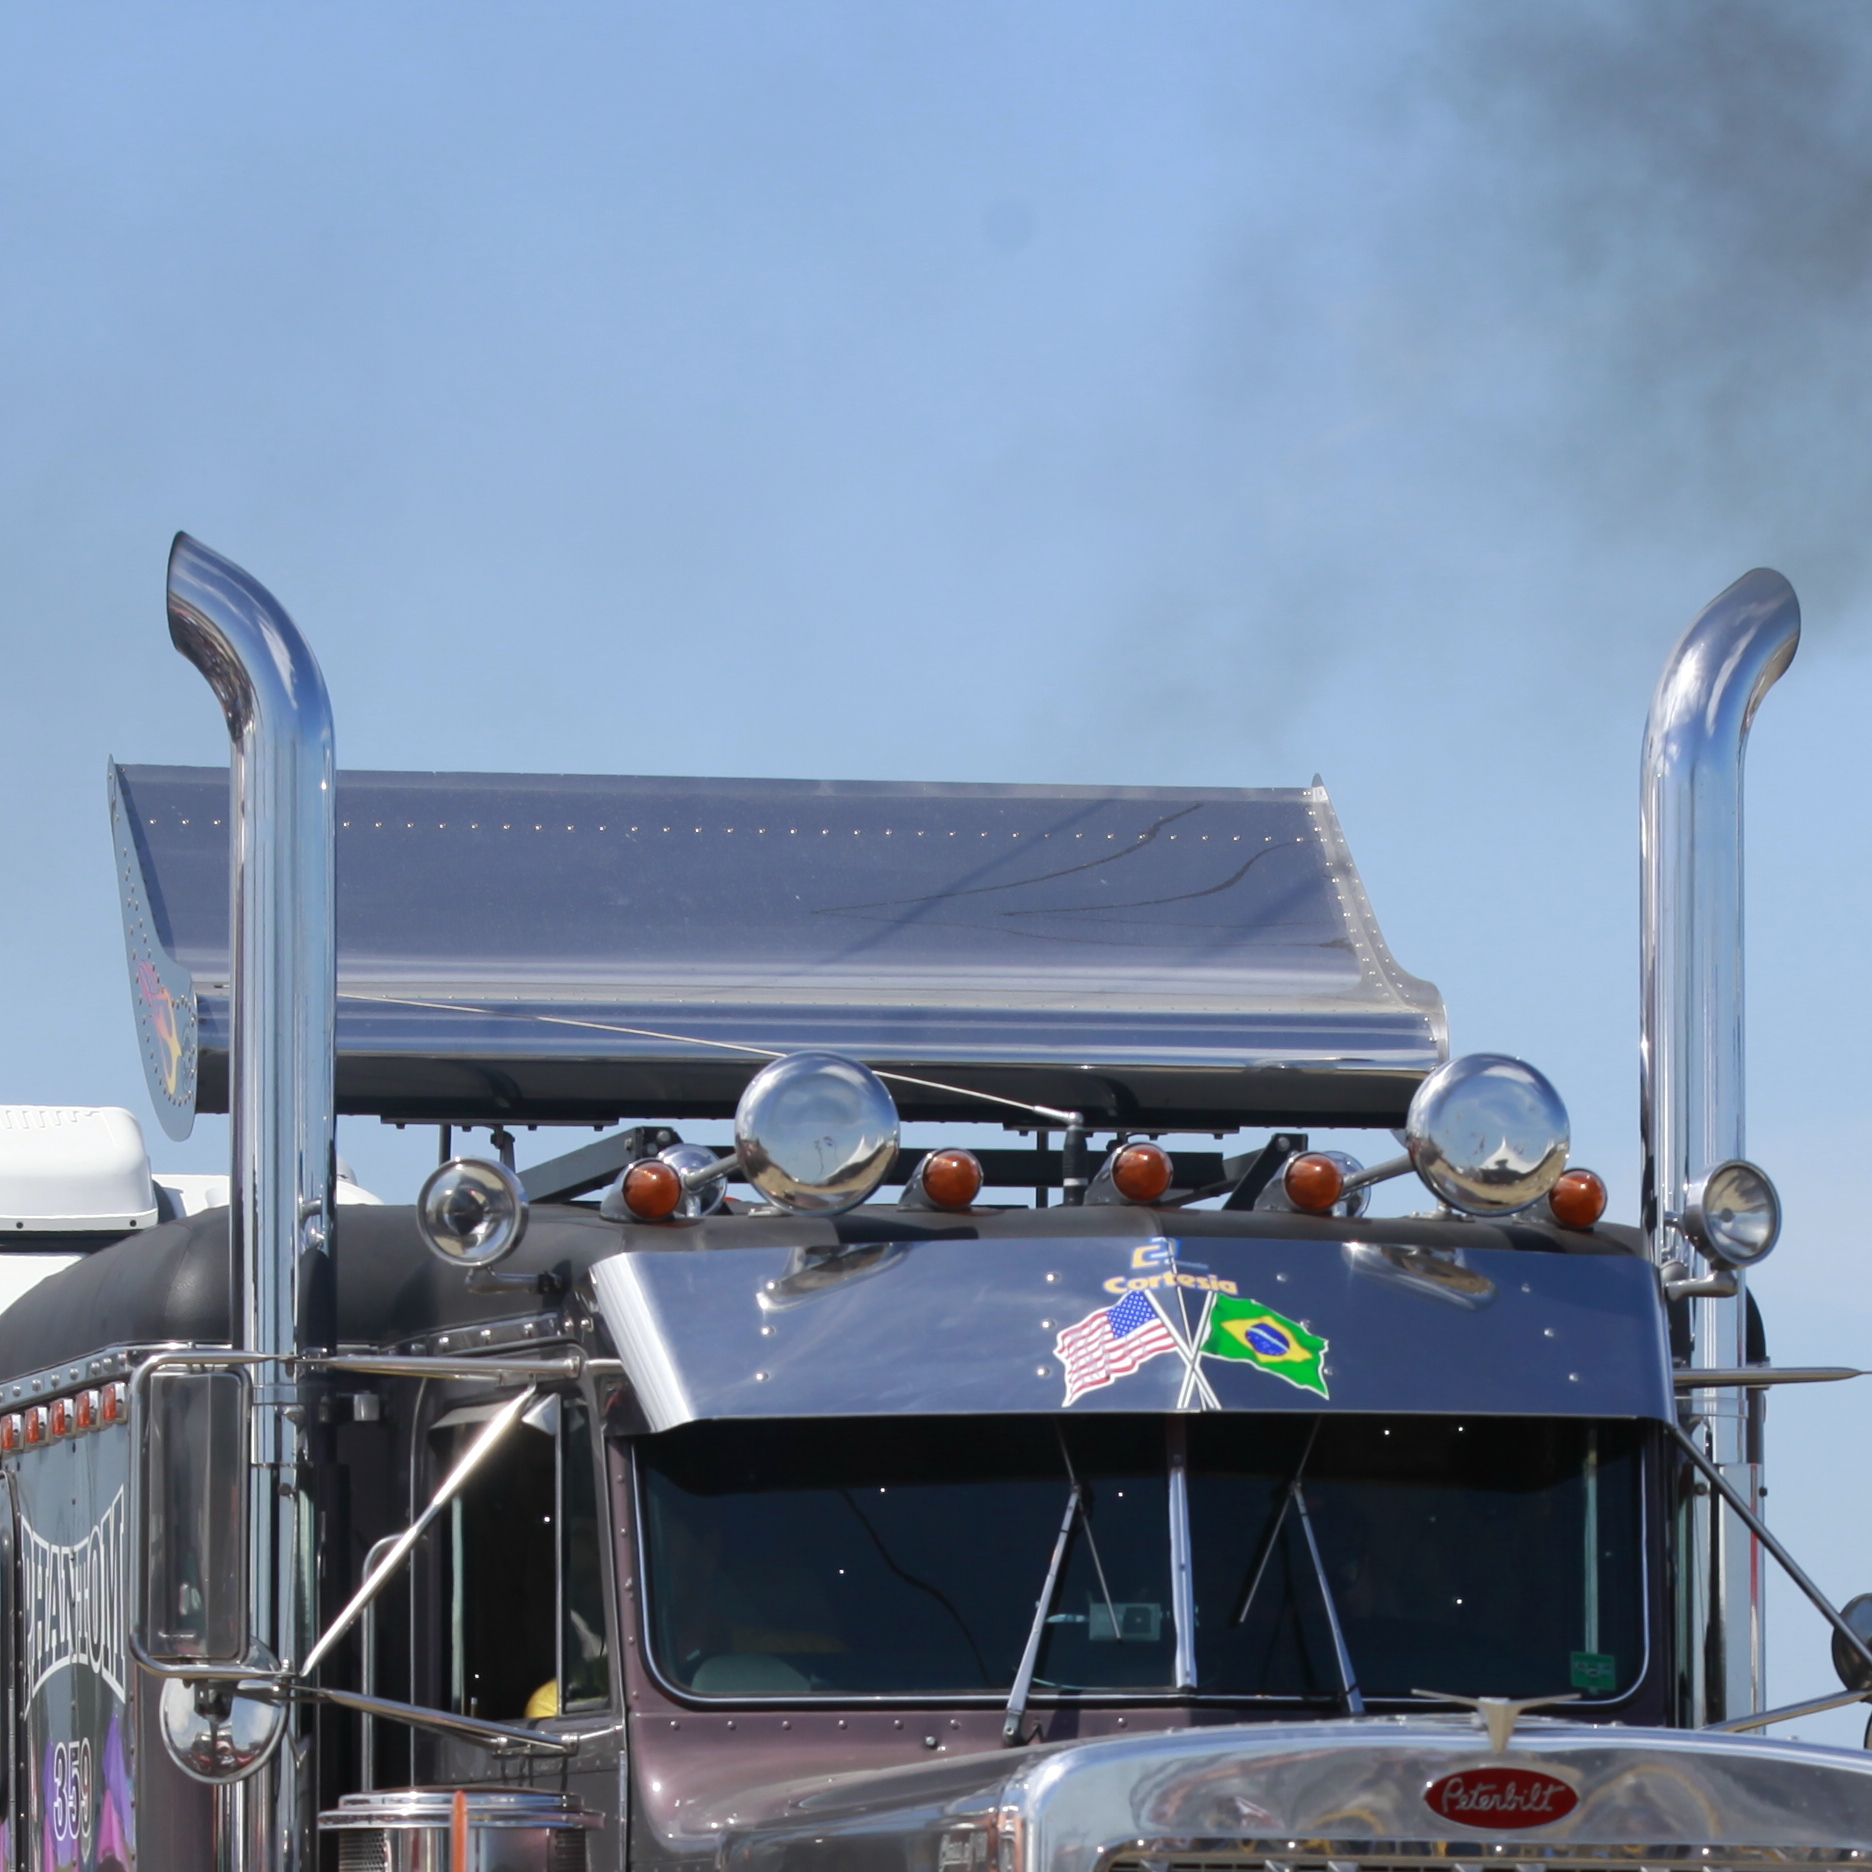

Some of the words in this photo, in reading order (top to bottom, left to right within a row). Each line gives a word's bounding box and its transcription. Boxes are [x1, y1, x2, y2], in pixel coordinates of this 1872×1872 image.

[1103, 1271, 1239, 1296] Cortesia
[21, 1483, 126, 1722] PHANTOM
[53, 1737, 92, 1840] 359
[1441, 1777, 1565, 1813] Peterbilt
